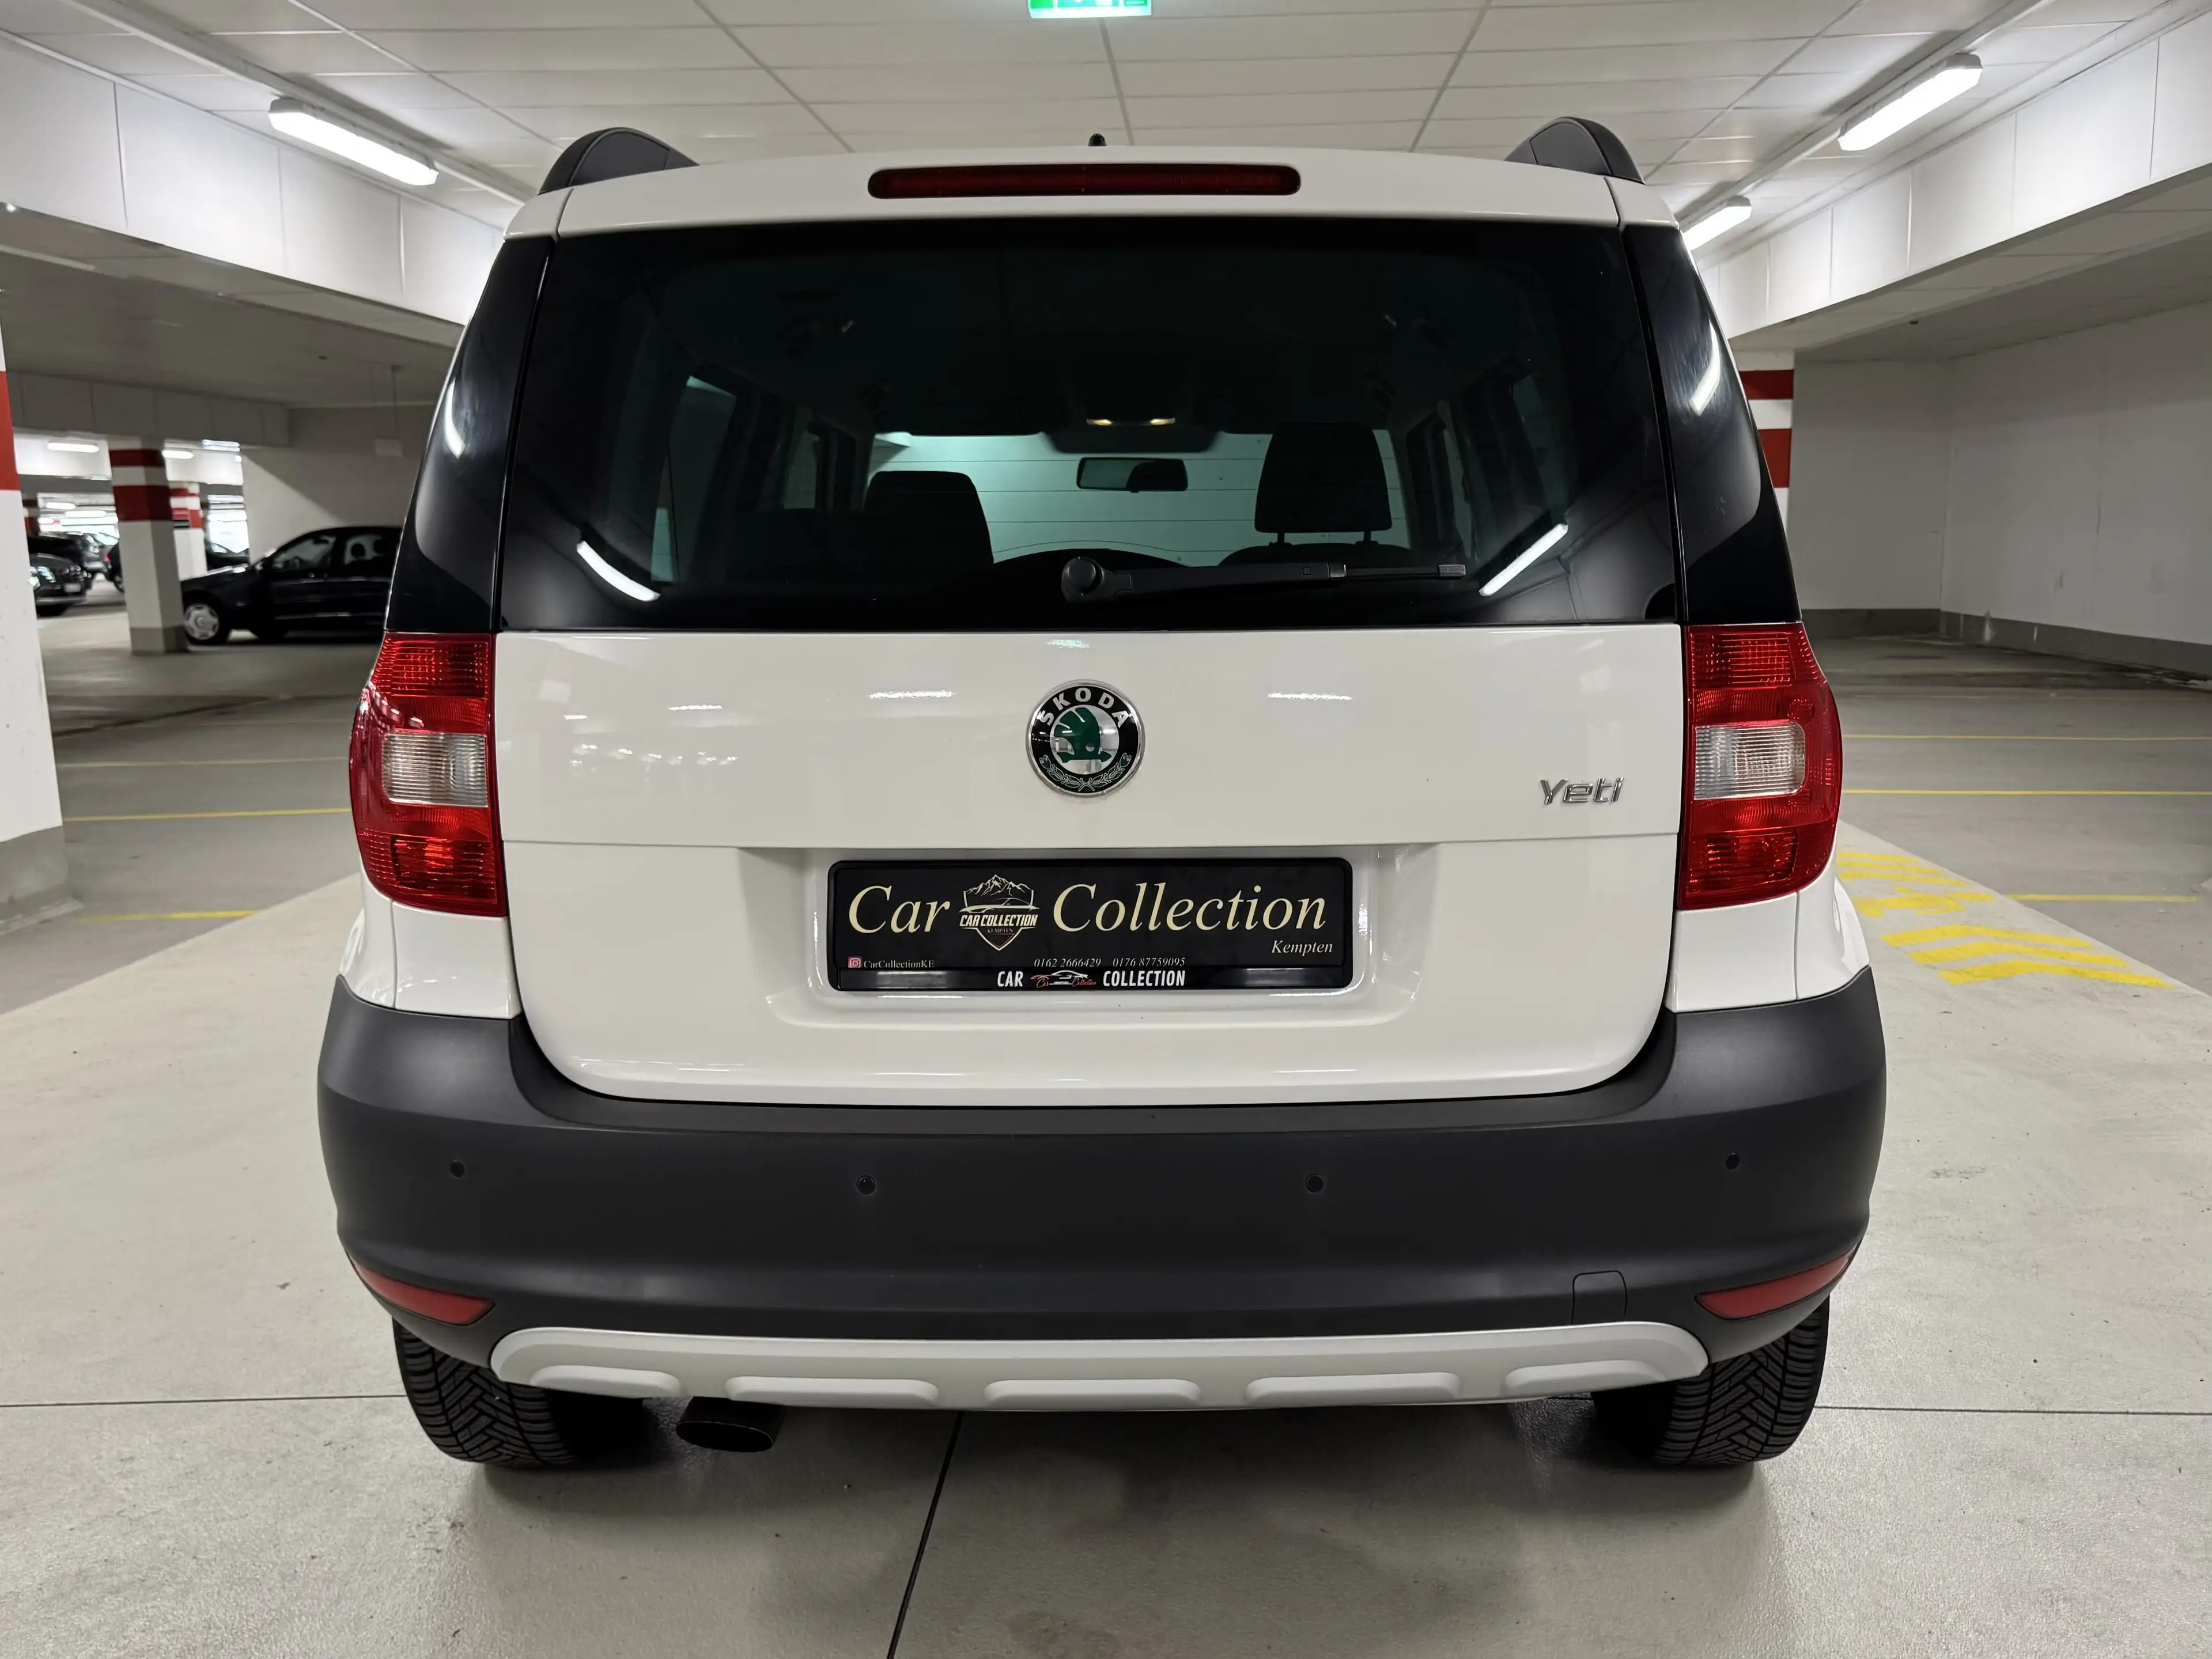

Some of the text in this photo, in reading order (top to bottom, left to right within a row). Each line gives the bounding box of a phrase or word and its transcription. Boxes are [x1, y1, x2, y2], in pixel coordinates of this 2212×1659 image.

[1540, 777, 1624, 805] Yeti
[849, 882, 1326, 934] Car Collection
[959, 914, 1038, 927] CAR COLLECTION
[1271, 940, 1333, 957] Kempten
[864, 959, 935, 968] CarCollectionKE
[1034, 958, 1102, 967] 0162 2666429
[1113, 957, 1186, 967] 0176 87759095
[997, 970, 1186, 987] CAR COLLECTION
